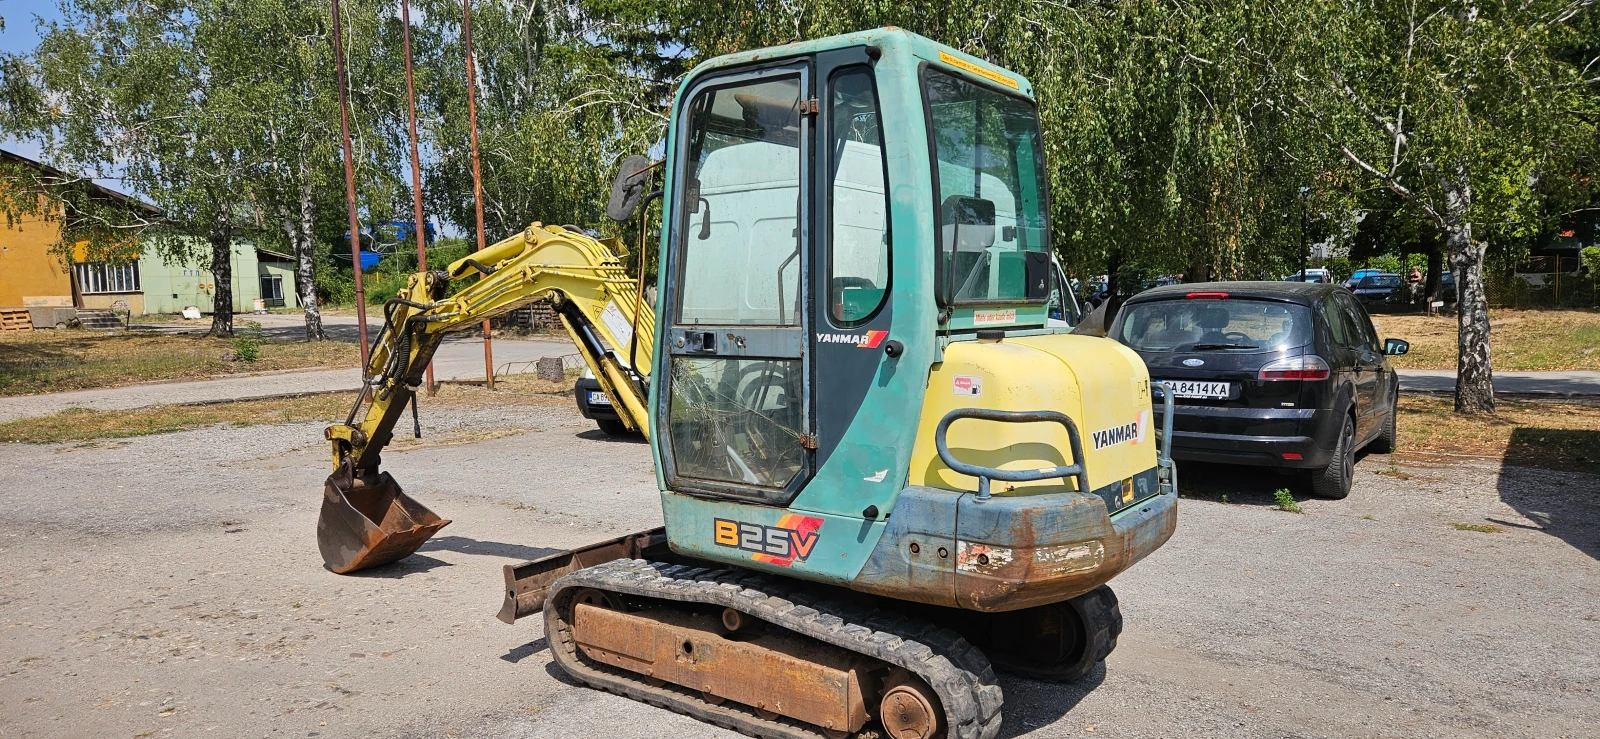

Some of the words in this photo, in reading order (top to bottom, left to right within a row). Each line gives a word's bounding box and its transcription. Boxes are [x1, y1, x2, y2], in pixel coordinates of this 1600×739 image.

[816, 333, 869, 344] YANMAR
[1092, 422, 1138, 450] YANMAR
[714, 517, 820, 561] B25V
